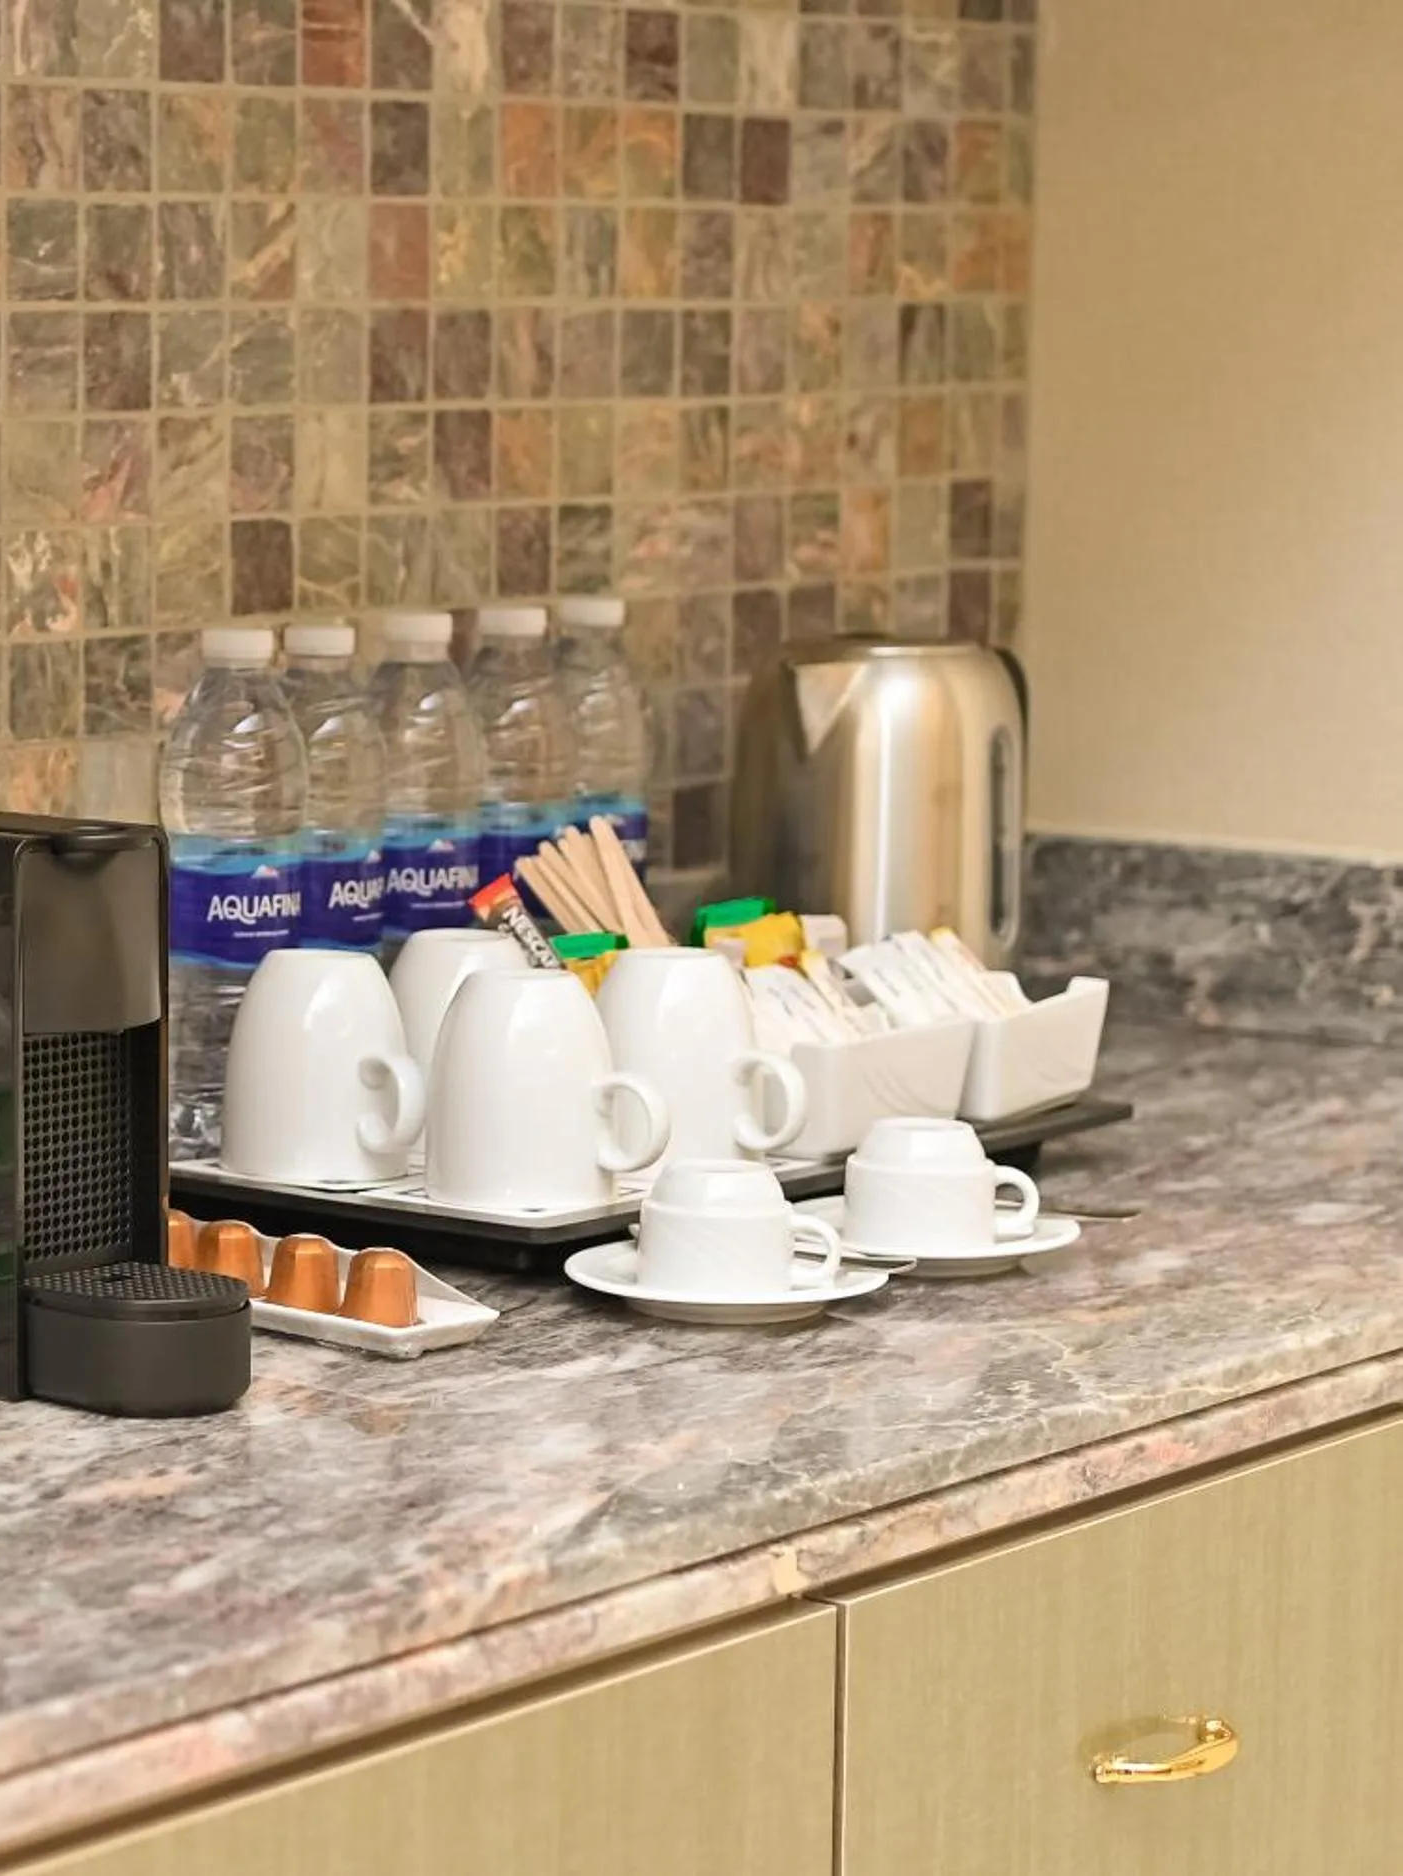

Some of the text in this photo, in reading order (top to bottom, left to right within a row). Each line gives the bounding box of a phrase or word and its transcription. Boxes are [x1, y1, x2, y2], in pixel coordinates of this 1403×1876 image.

[328, 876, 385, 910] AQUA
[386, 866, 479, 898] AQUAFIN
[206, 892, 302, 926] AQUAFIN
[501, 905, 562, 970] NESCA
